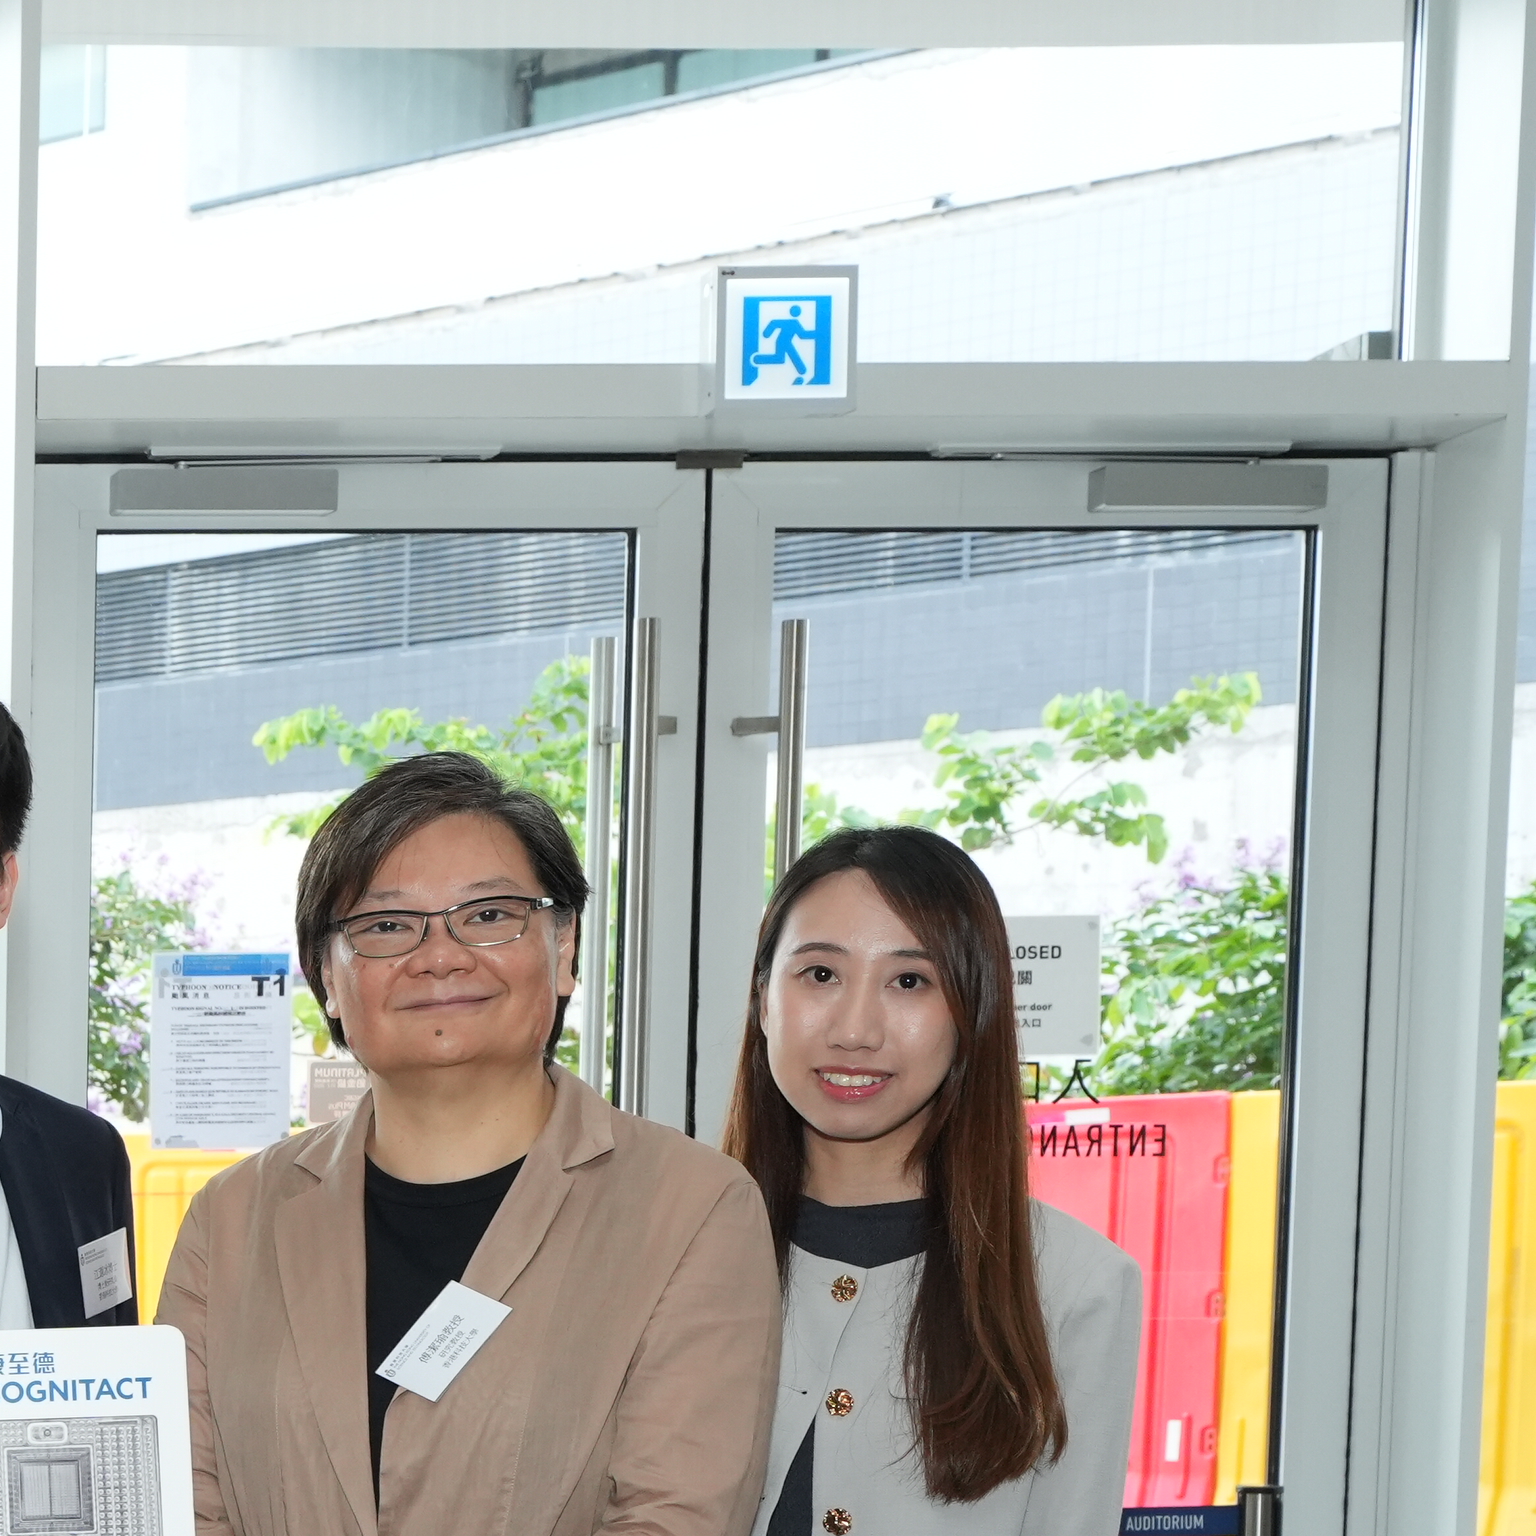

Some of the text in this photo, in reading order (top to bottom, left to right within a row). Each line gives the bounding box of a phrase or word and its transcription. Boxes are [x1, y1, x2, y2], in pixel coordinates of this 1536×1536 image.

[1013, 970, 1033, 985] 關
[1030, 1003, 1053, 1011] door
[1018, 1018, 1042, 1028] 入口
[1126, 1514, 1204, 1531] AUDITORIUM
